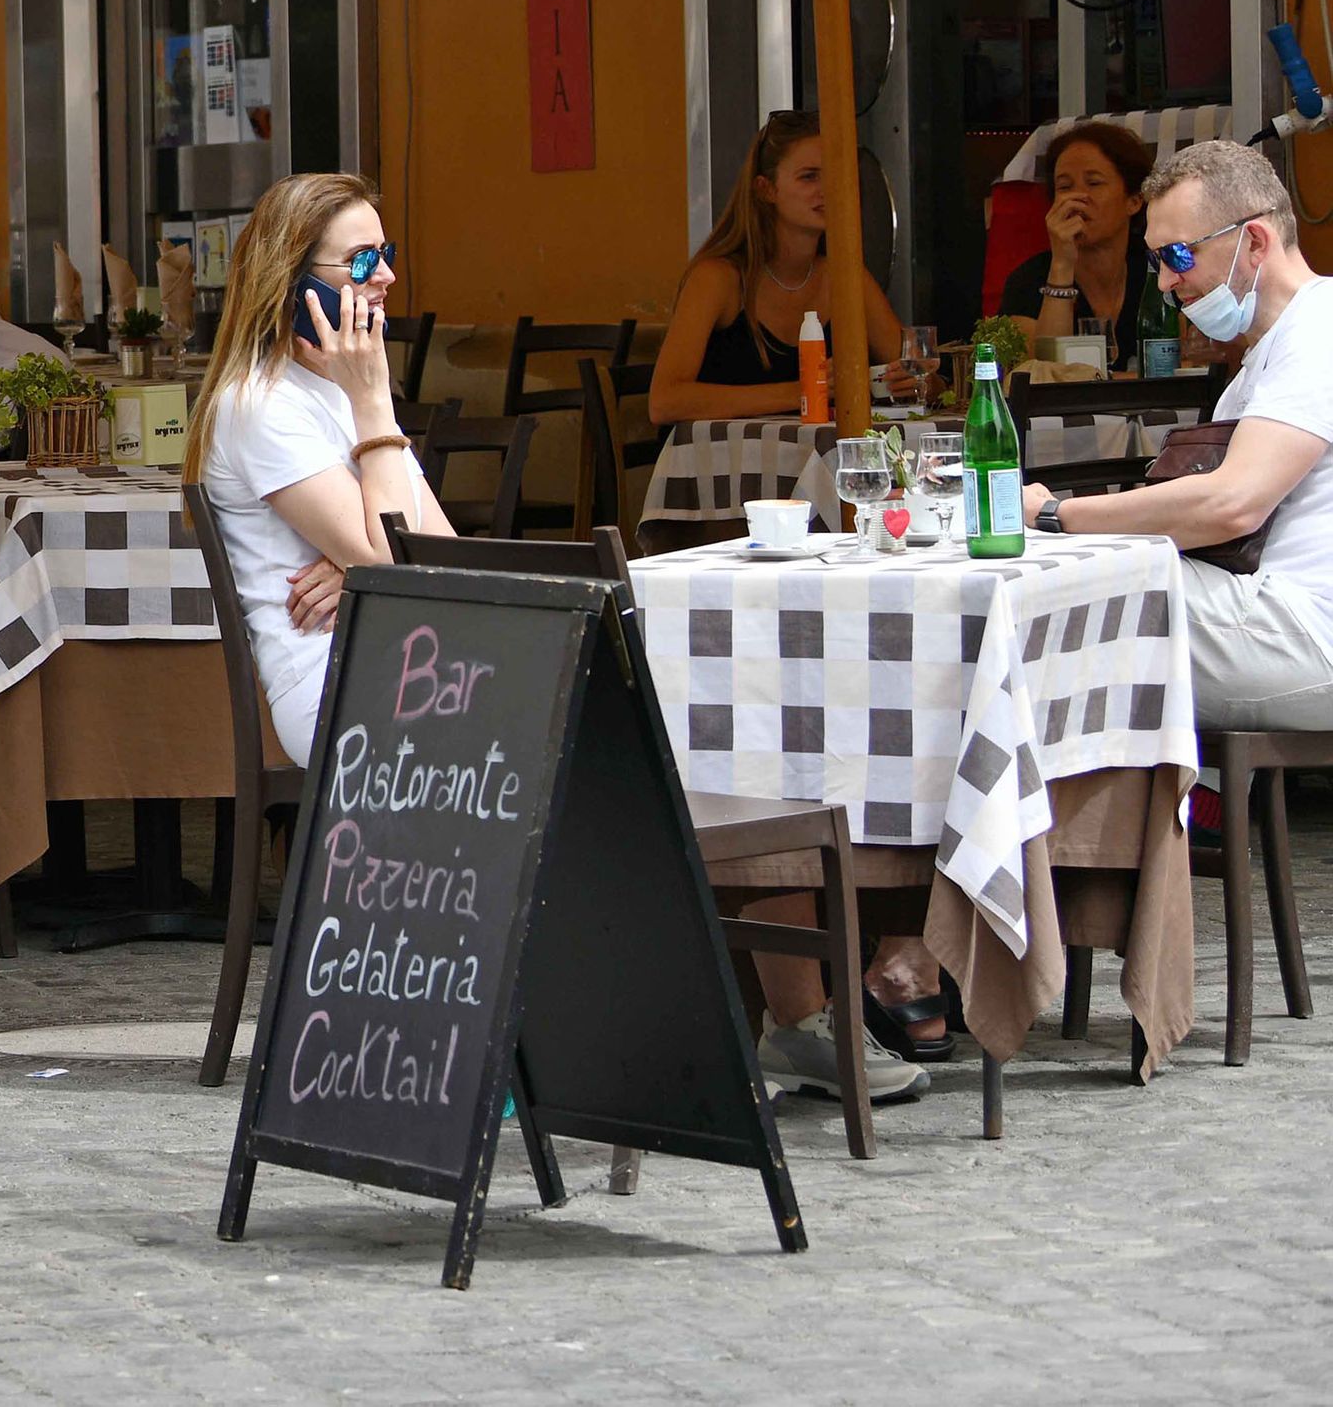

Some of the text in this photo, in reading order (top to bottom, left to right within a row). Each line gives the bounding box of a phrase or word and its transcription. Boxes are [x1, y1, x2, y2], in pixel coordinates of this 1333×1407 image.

[393, 624, 494, 720] Bar
[328, 723, 520, 821] Ristorante
[322, 818, 480, 922] Pizzeria
[305, 917, 482, 1007] Gelateria
